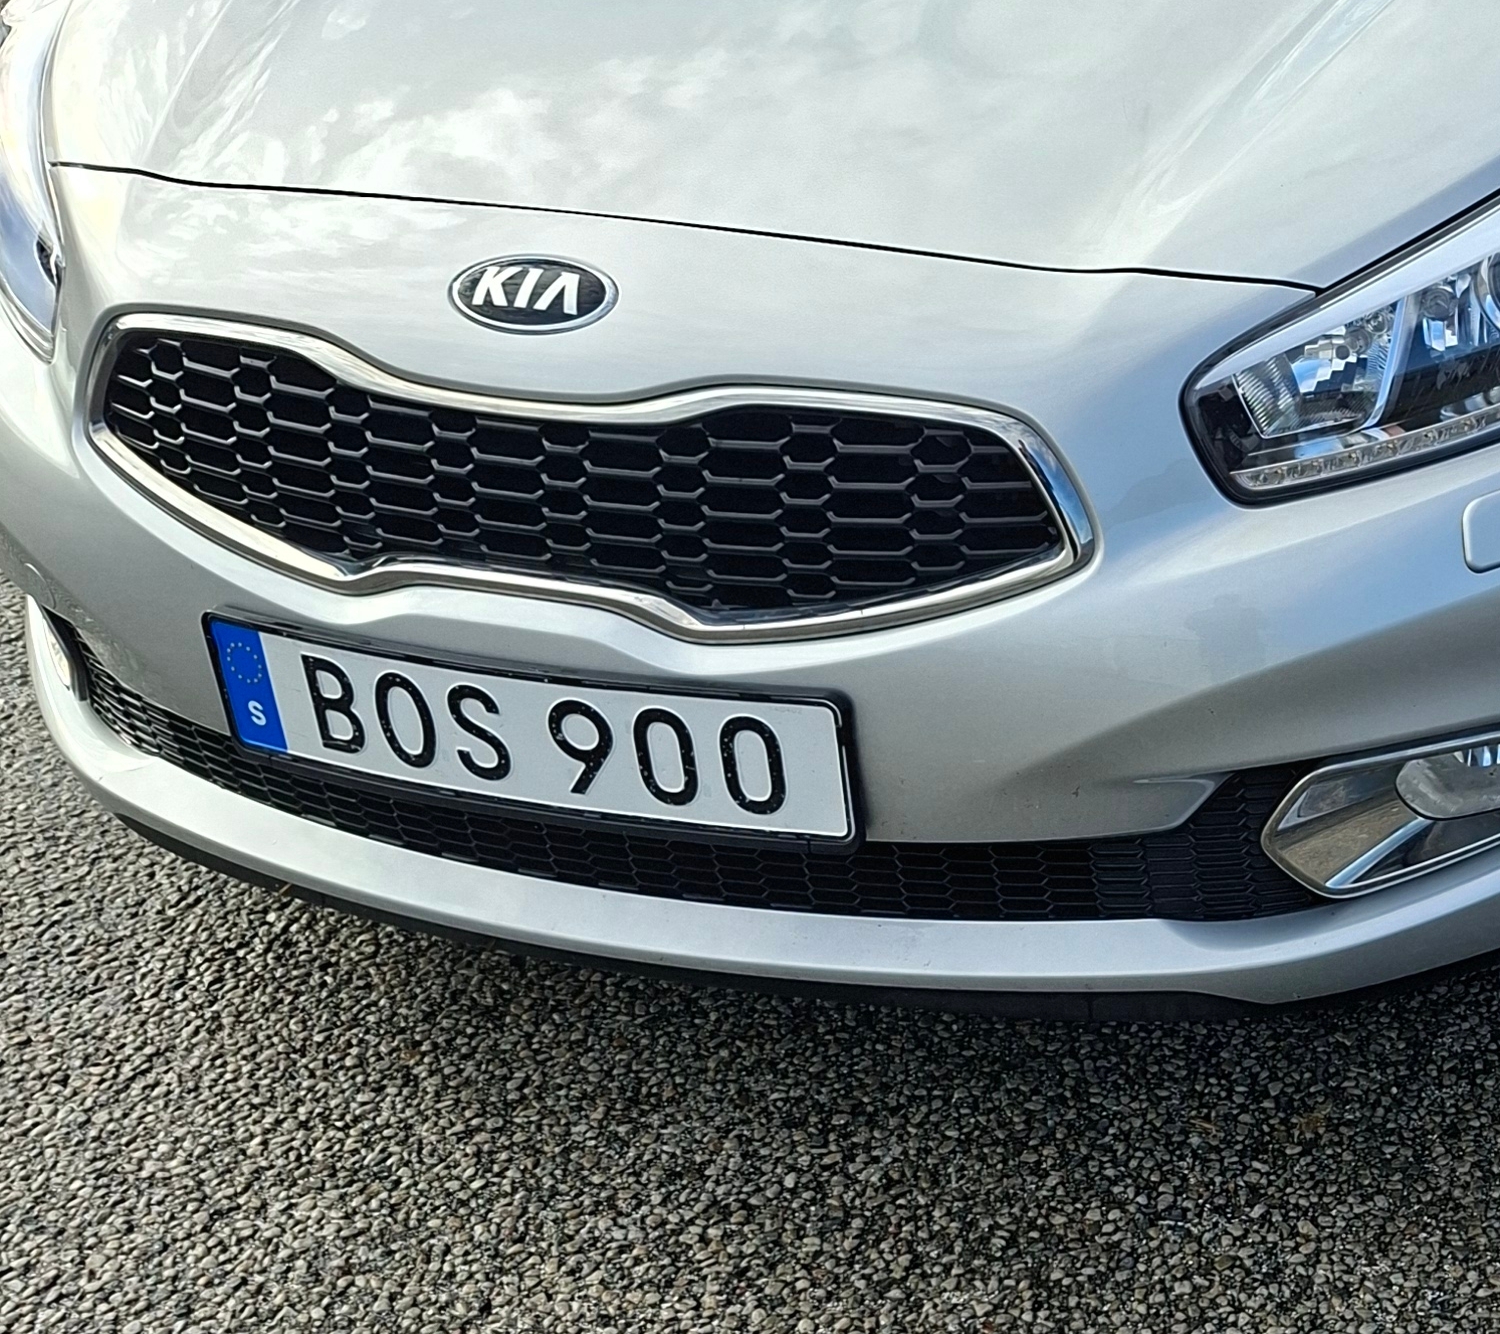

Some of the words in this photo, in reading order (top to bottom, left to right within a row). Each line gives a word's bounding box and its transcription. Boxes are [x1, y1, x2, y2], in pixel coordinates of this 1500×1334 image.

[472, 266, 581, 316] KIA
[247, 700, 267, 726] S
[301, 654, 511, 781] BOS
[548, 699, 786, 815] 900
